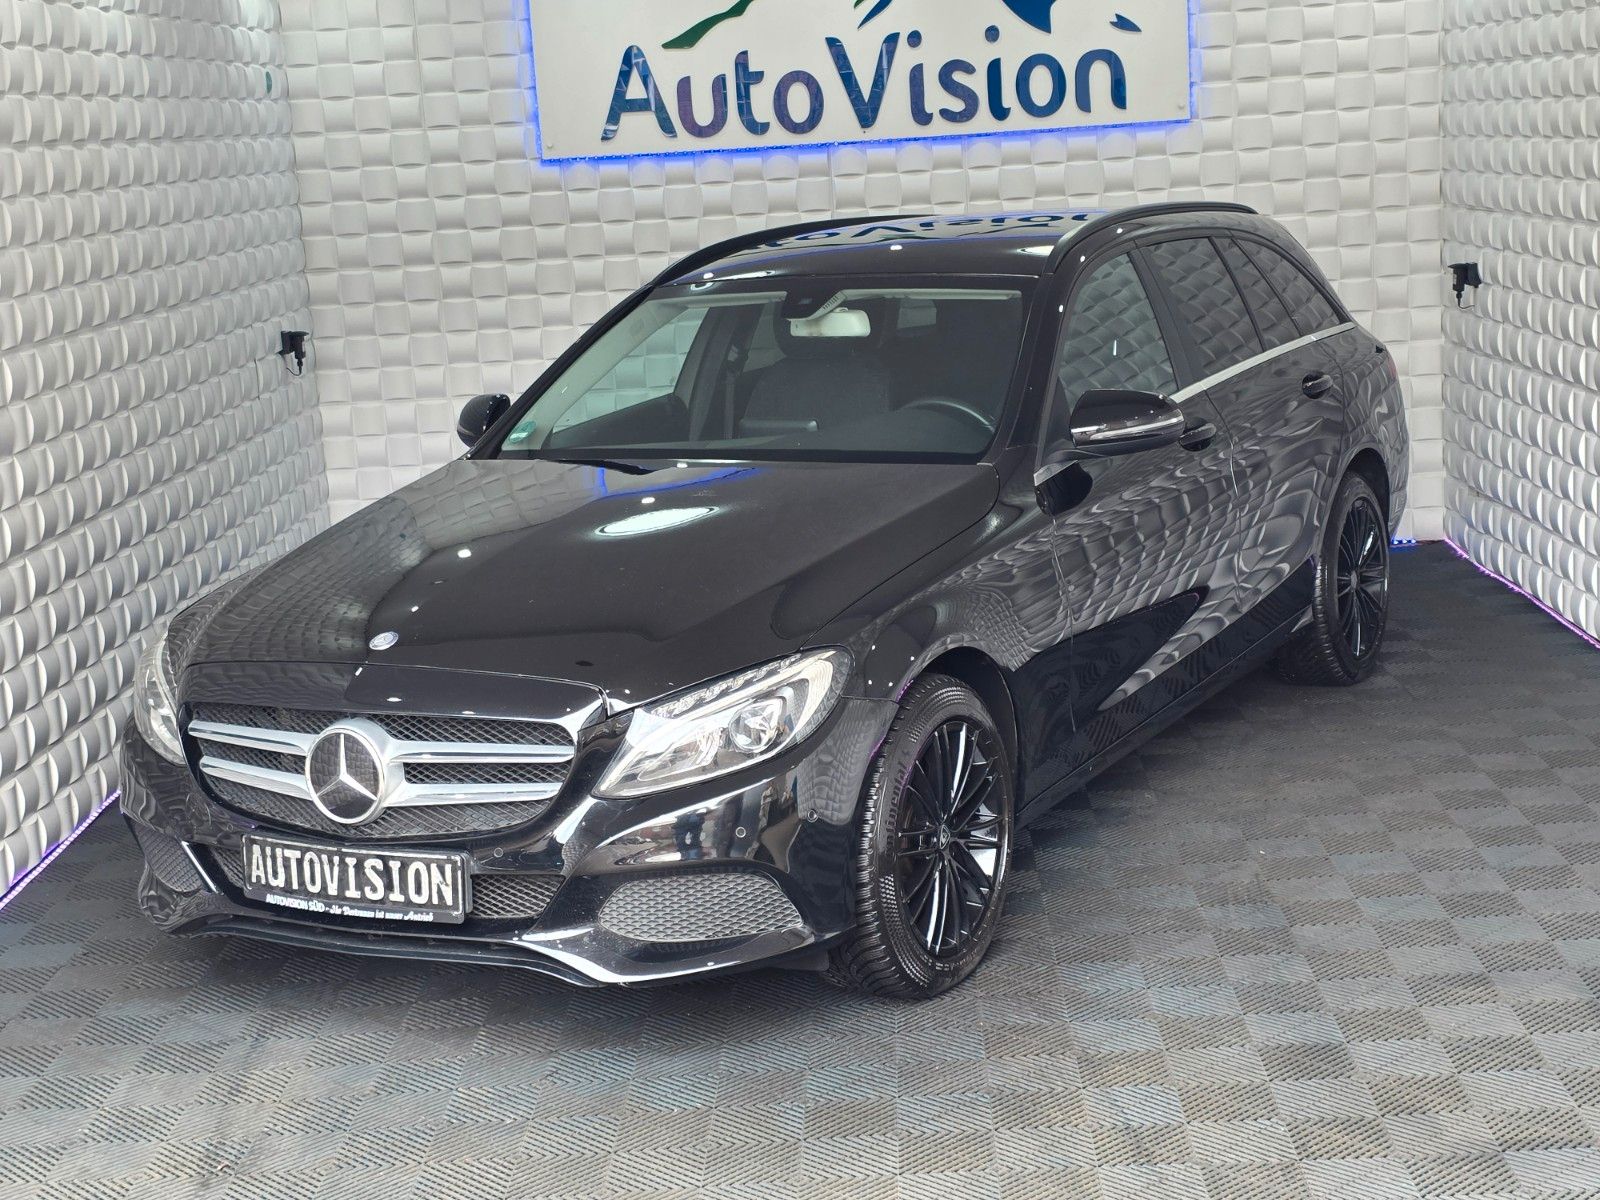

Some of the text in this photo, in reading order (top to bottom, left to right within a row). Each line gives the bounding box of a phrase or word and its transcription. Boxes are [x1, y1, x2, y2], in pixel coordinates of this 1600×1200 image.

[601, 25, 1128, 142] AutoVision
[251, 844, 453, 906] AUTOVISION
[266, 893, 308, 910] AUTOVISION
[308, 899, 325, 912] SÜD
[403, 910, 434, 922] Antrieb
